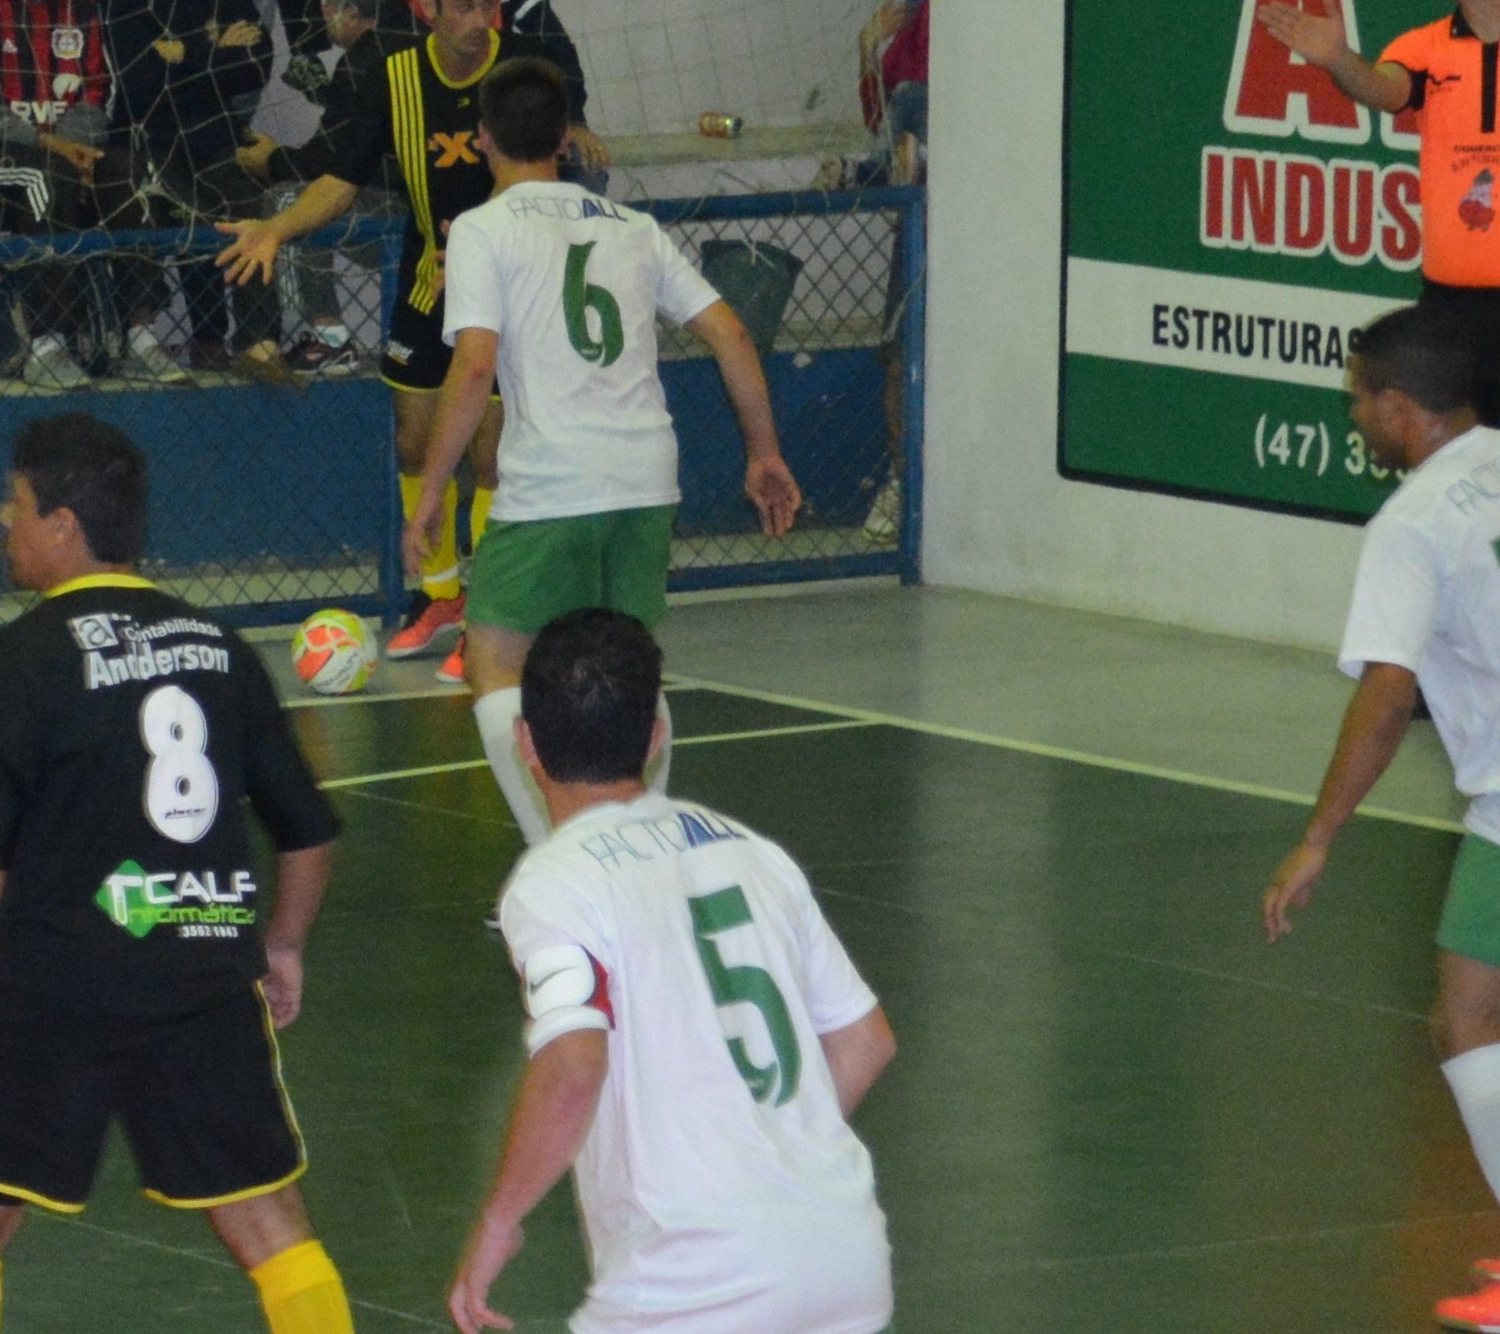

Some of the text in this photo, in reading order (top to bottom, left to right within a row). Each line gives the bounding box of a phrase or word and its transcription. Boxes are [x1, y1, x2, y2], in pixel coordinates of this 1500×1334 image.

[562, 240, 626, 368] 6
[1254, 413, 1331, 477] (47)
[138, 684, 220, 844] 8
[686, 883, 802, 1110] 5
